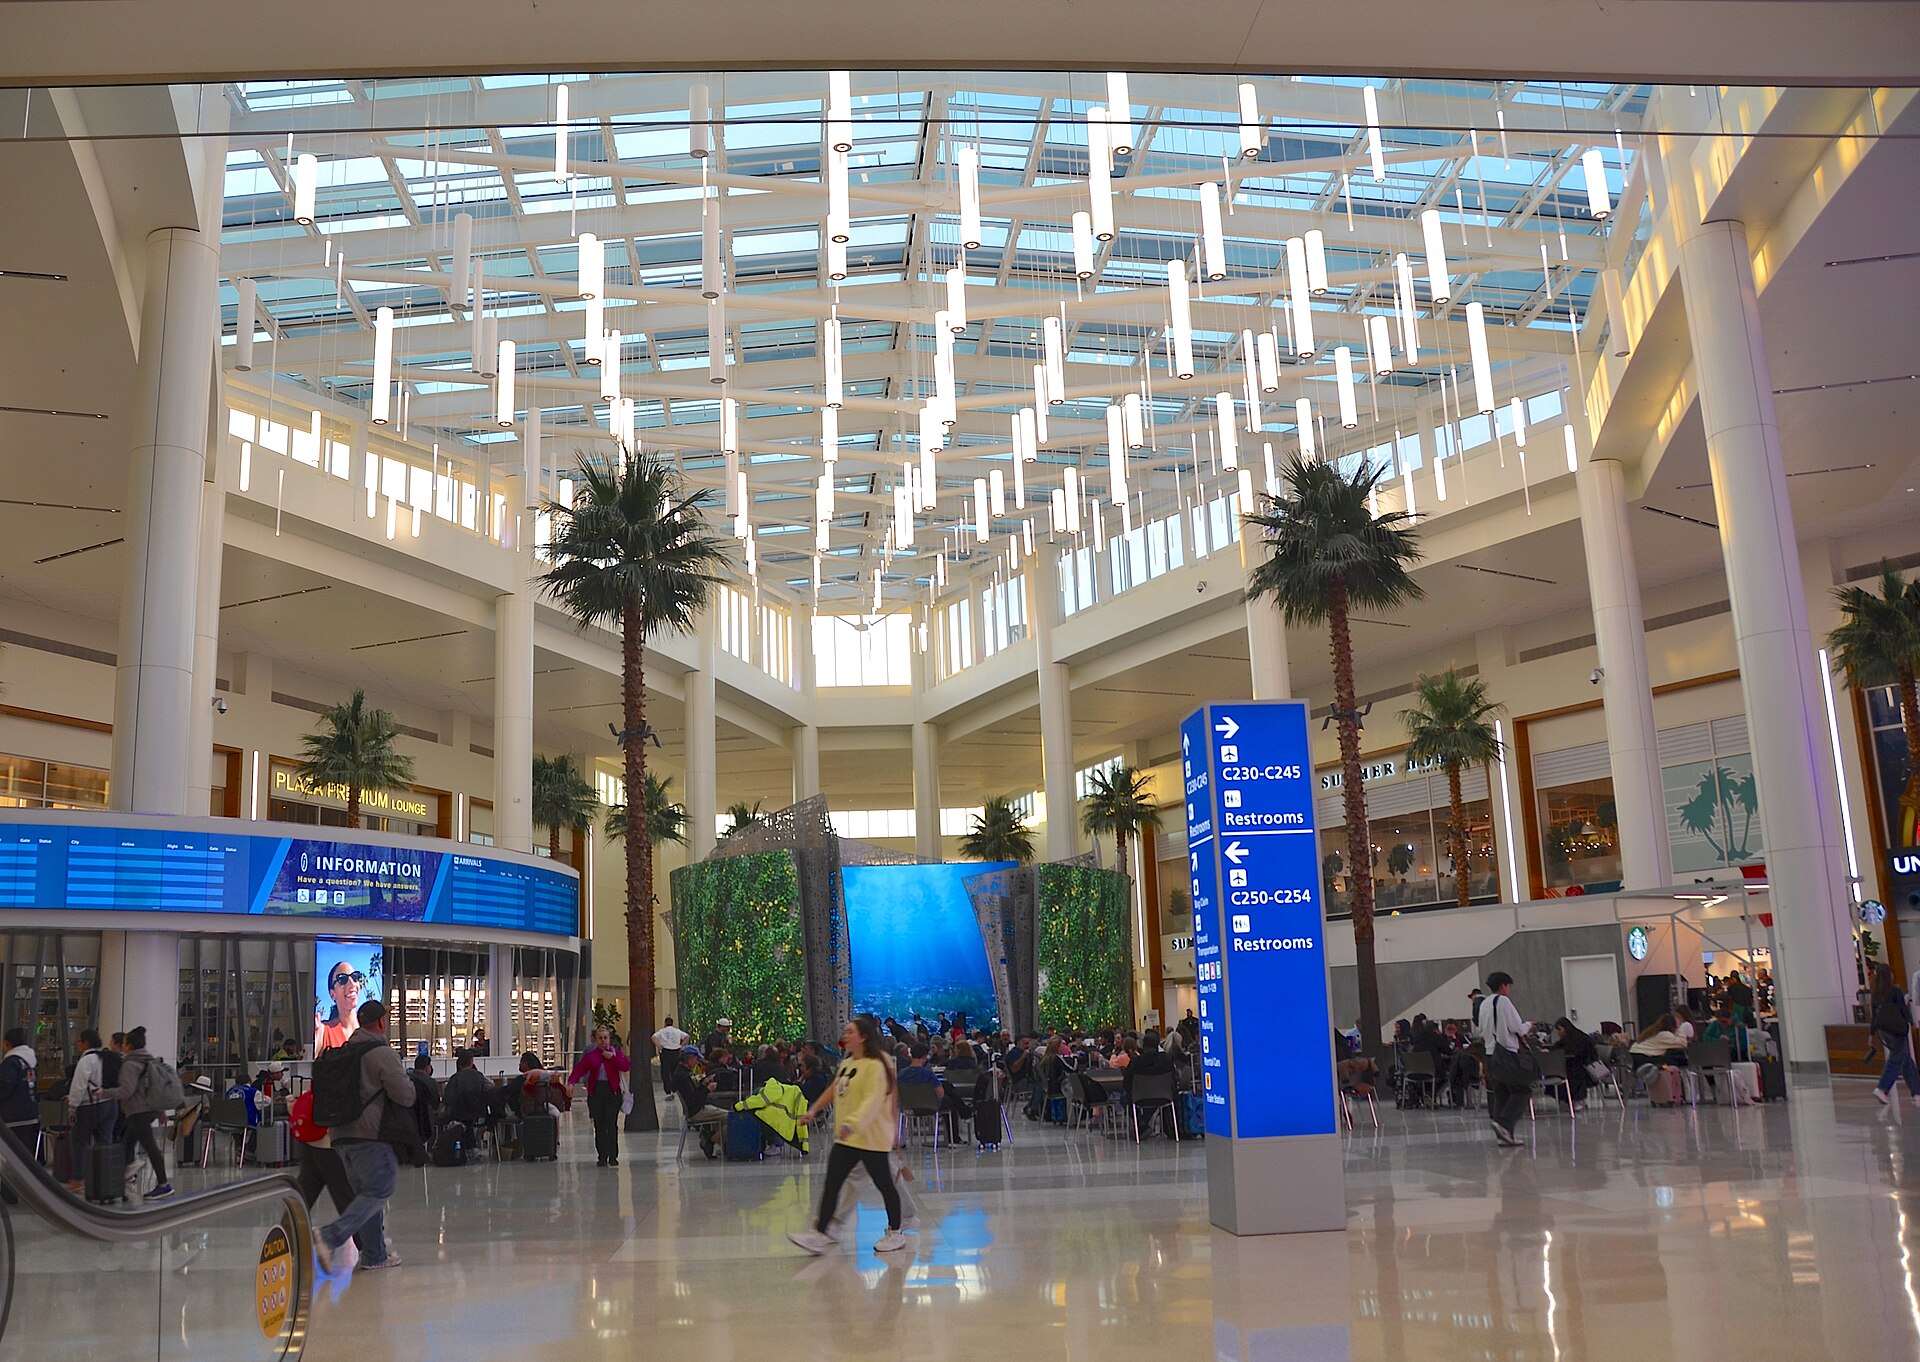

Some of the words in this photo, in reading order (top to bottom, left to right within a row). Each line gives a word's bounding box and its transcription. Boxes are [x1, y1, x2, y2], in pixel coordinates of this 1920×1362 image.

[1222, 766, 1301, 781] C230-C245
[276, 771, 324, 797] PLAZA
[391, 799, 427, 816] LOUNGE
[1225, 812, 1304, 826] Restrooms
[1189, 819, 1211, 838] Restrooms
[316, 856, 421, 878] INFORMATION
[459, 857, 482, 867] ARRIVALS
[297, 875, 317, 884] Have
[325, 879, 361, 888] question?
[363, 880, 374, 888] We
[392, 883, 420, 891] answers.
[1231, 889, 1311, 906] C250-C254
[1233, 937, 1313, 952] Restrooms
[264, 1239, 285, 1257] CAUTION
